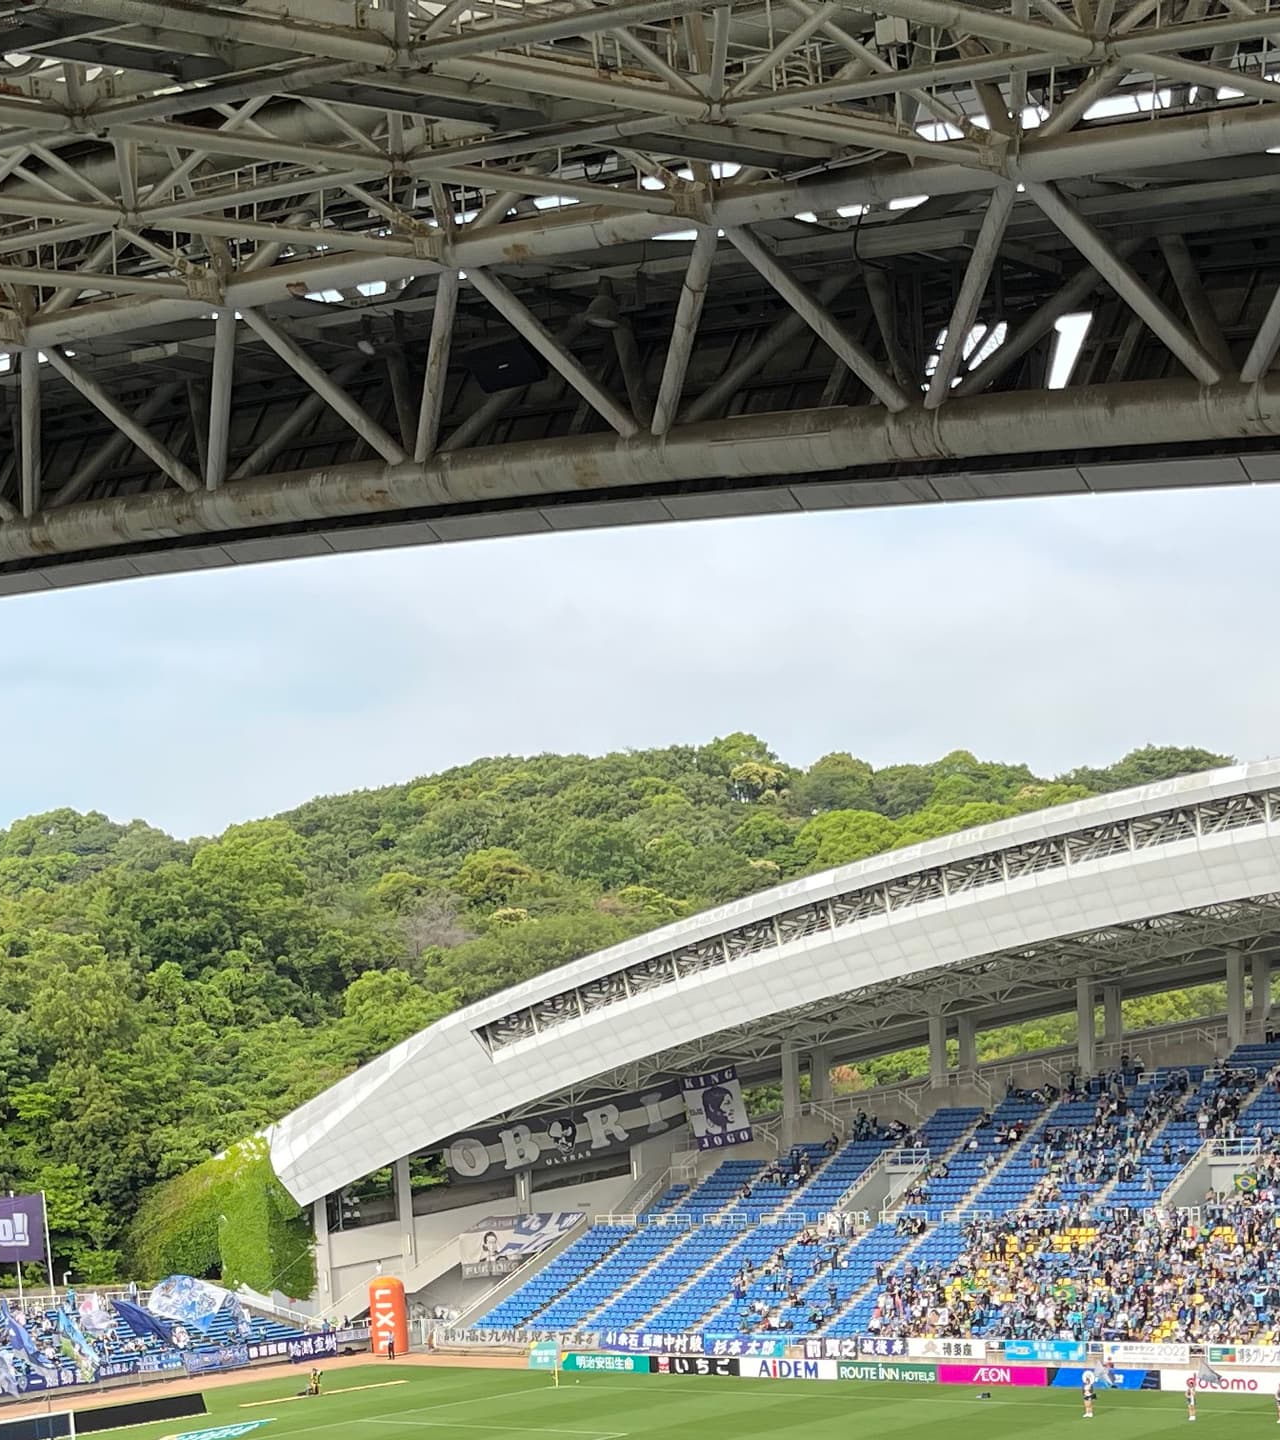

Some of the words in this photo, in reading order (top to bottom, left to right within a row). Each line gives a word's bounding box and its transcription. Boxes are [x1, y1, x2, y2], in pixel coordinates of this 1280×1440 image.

[684, 1069, 732, 1088] KING
[702, 1130, 749, 1148] JOGO
[713, 1340, 776, 1355] 杉本太郎
[942, 1342, 973, 1356] 博多座
[1158, 1346, 1187, 1357] 2022
[575, 1355, 634, 1370] 明治安田生命
[674, 1357, 731, 1375] いちご
[759, 1359, 819, 1378] AiDEM
[840, 1366, 876, 1379] ROUTE
[902, 1372, 935, 1382] HOTELS
